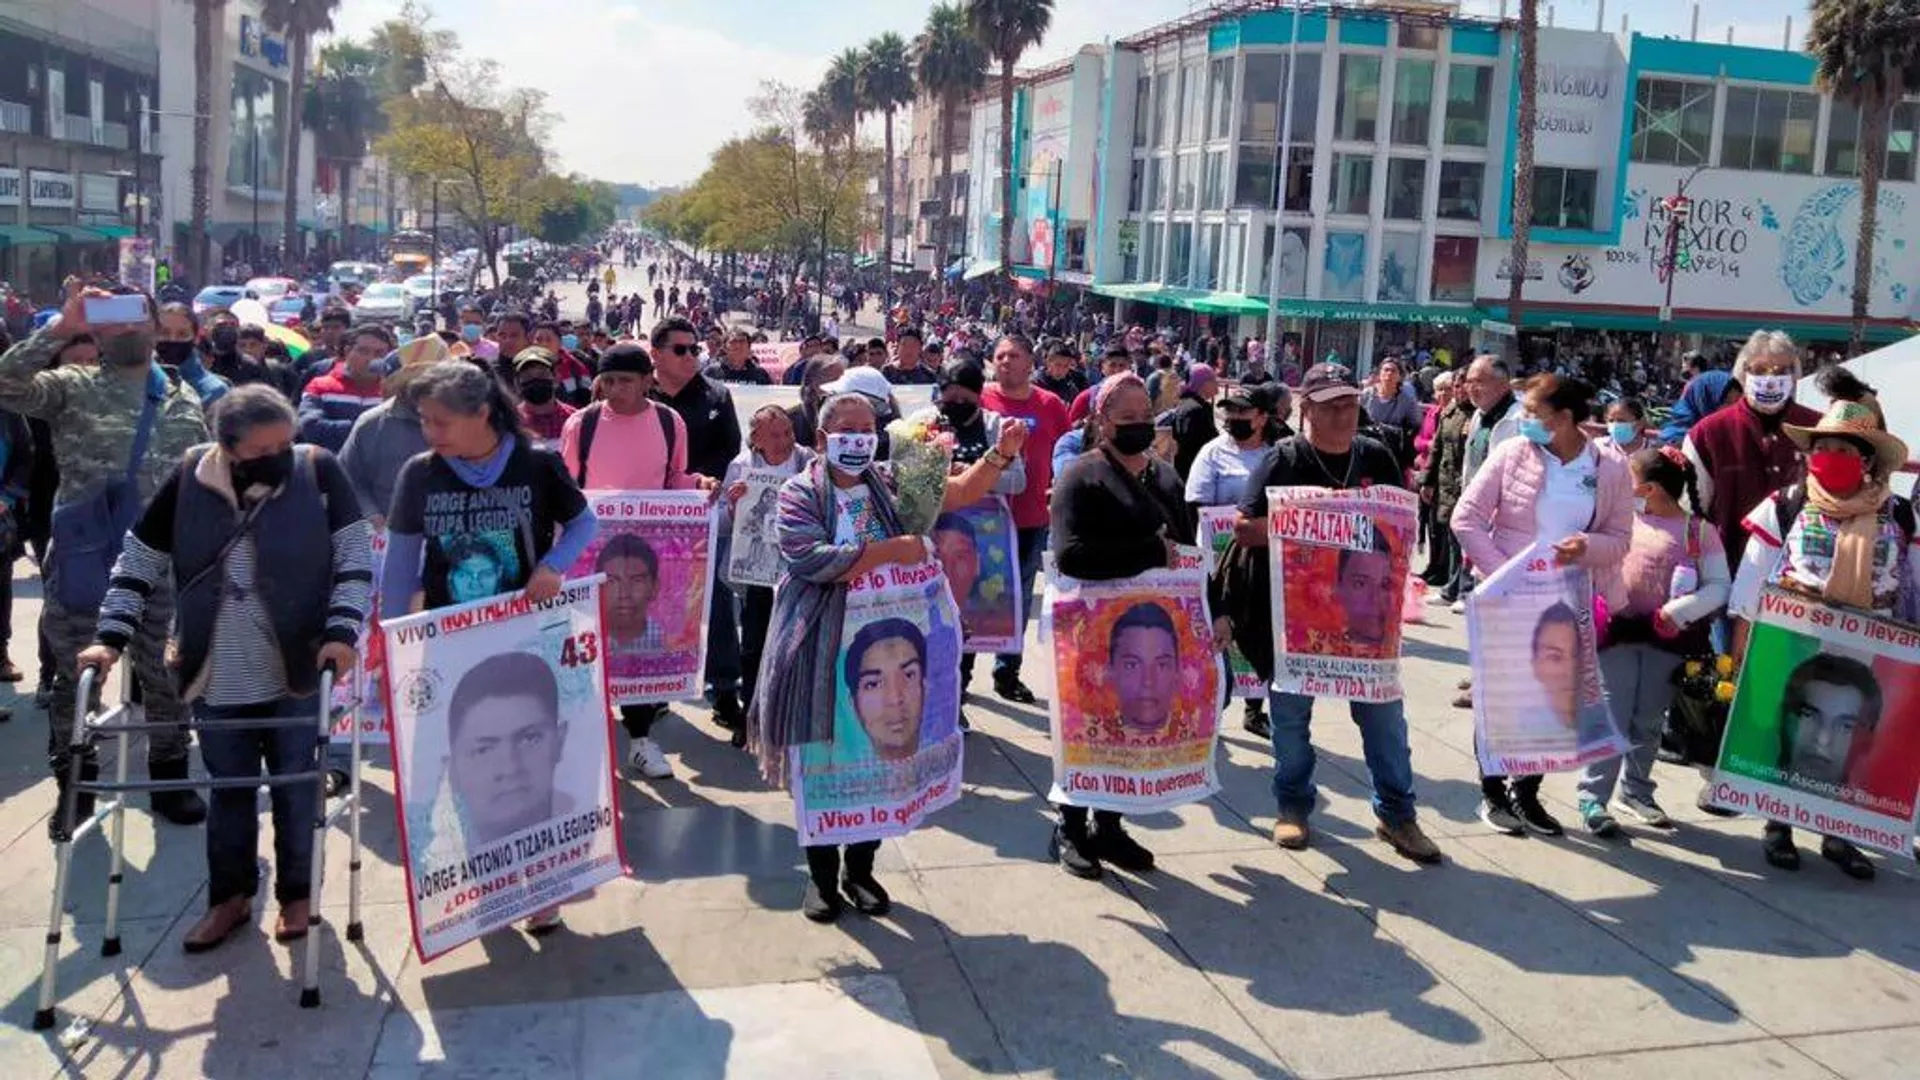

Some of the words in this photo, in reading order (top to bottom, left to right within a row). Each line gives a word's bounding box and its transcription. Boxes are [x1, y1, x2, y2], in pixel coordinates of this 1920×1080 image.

[424, 491, 467, 514] JORGE
[596, 503, 615, 516] se
[620, 501, 634, 515] lo
[639, 501, 707, 517] llevaron!
[1271, 508, 1299, 537] NOS
[1303, 511, 1351, 544] FALTAN
[868, 571, 885, 590] lo
[1757, 592, 1805, 619] ¡Vivo
[1809, 608, 1835, 627] se
[1839, 613, 1860, 633] lo
[397, 621, 438, 646] VIVO
[559, 630, 599, 668] 43
[609, 677, 688, 699] queremos!
[1334, 678, 1367, 697] VIDA
[1069, 772, 1099, 792] ¡Con
[1102, 773, 1137, 796] VIDA
[1140, 777, 1153, 796] lo
[817, 810, 865, 833] ¡Vivo
[870, 805, 889, 823] lo
[1711, 782, 1749, 805] ¡Con
[1754, 791, 1790, 819] Vida
[1794, 803, 1810, 824] lo
[1814, 813, 1906, 851] queremos!
[417, 866, 458, 901] JORGE
[460, 846, 513, 883] ANTONIO
[514, 826, 554, 862] TIZAPA
[444, 871, 520, 914] ¿DONDE
